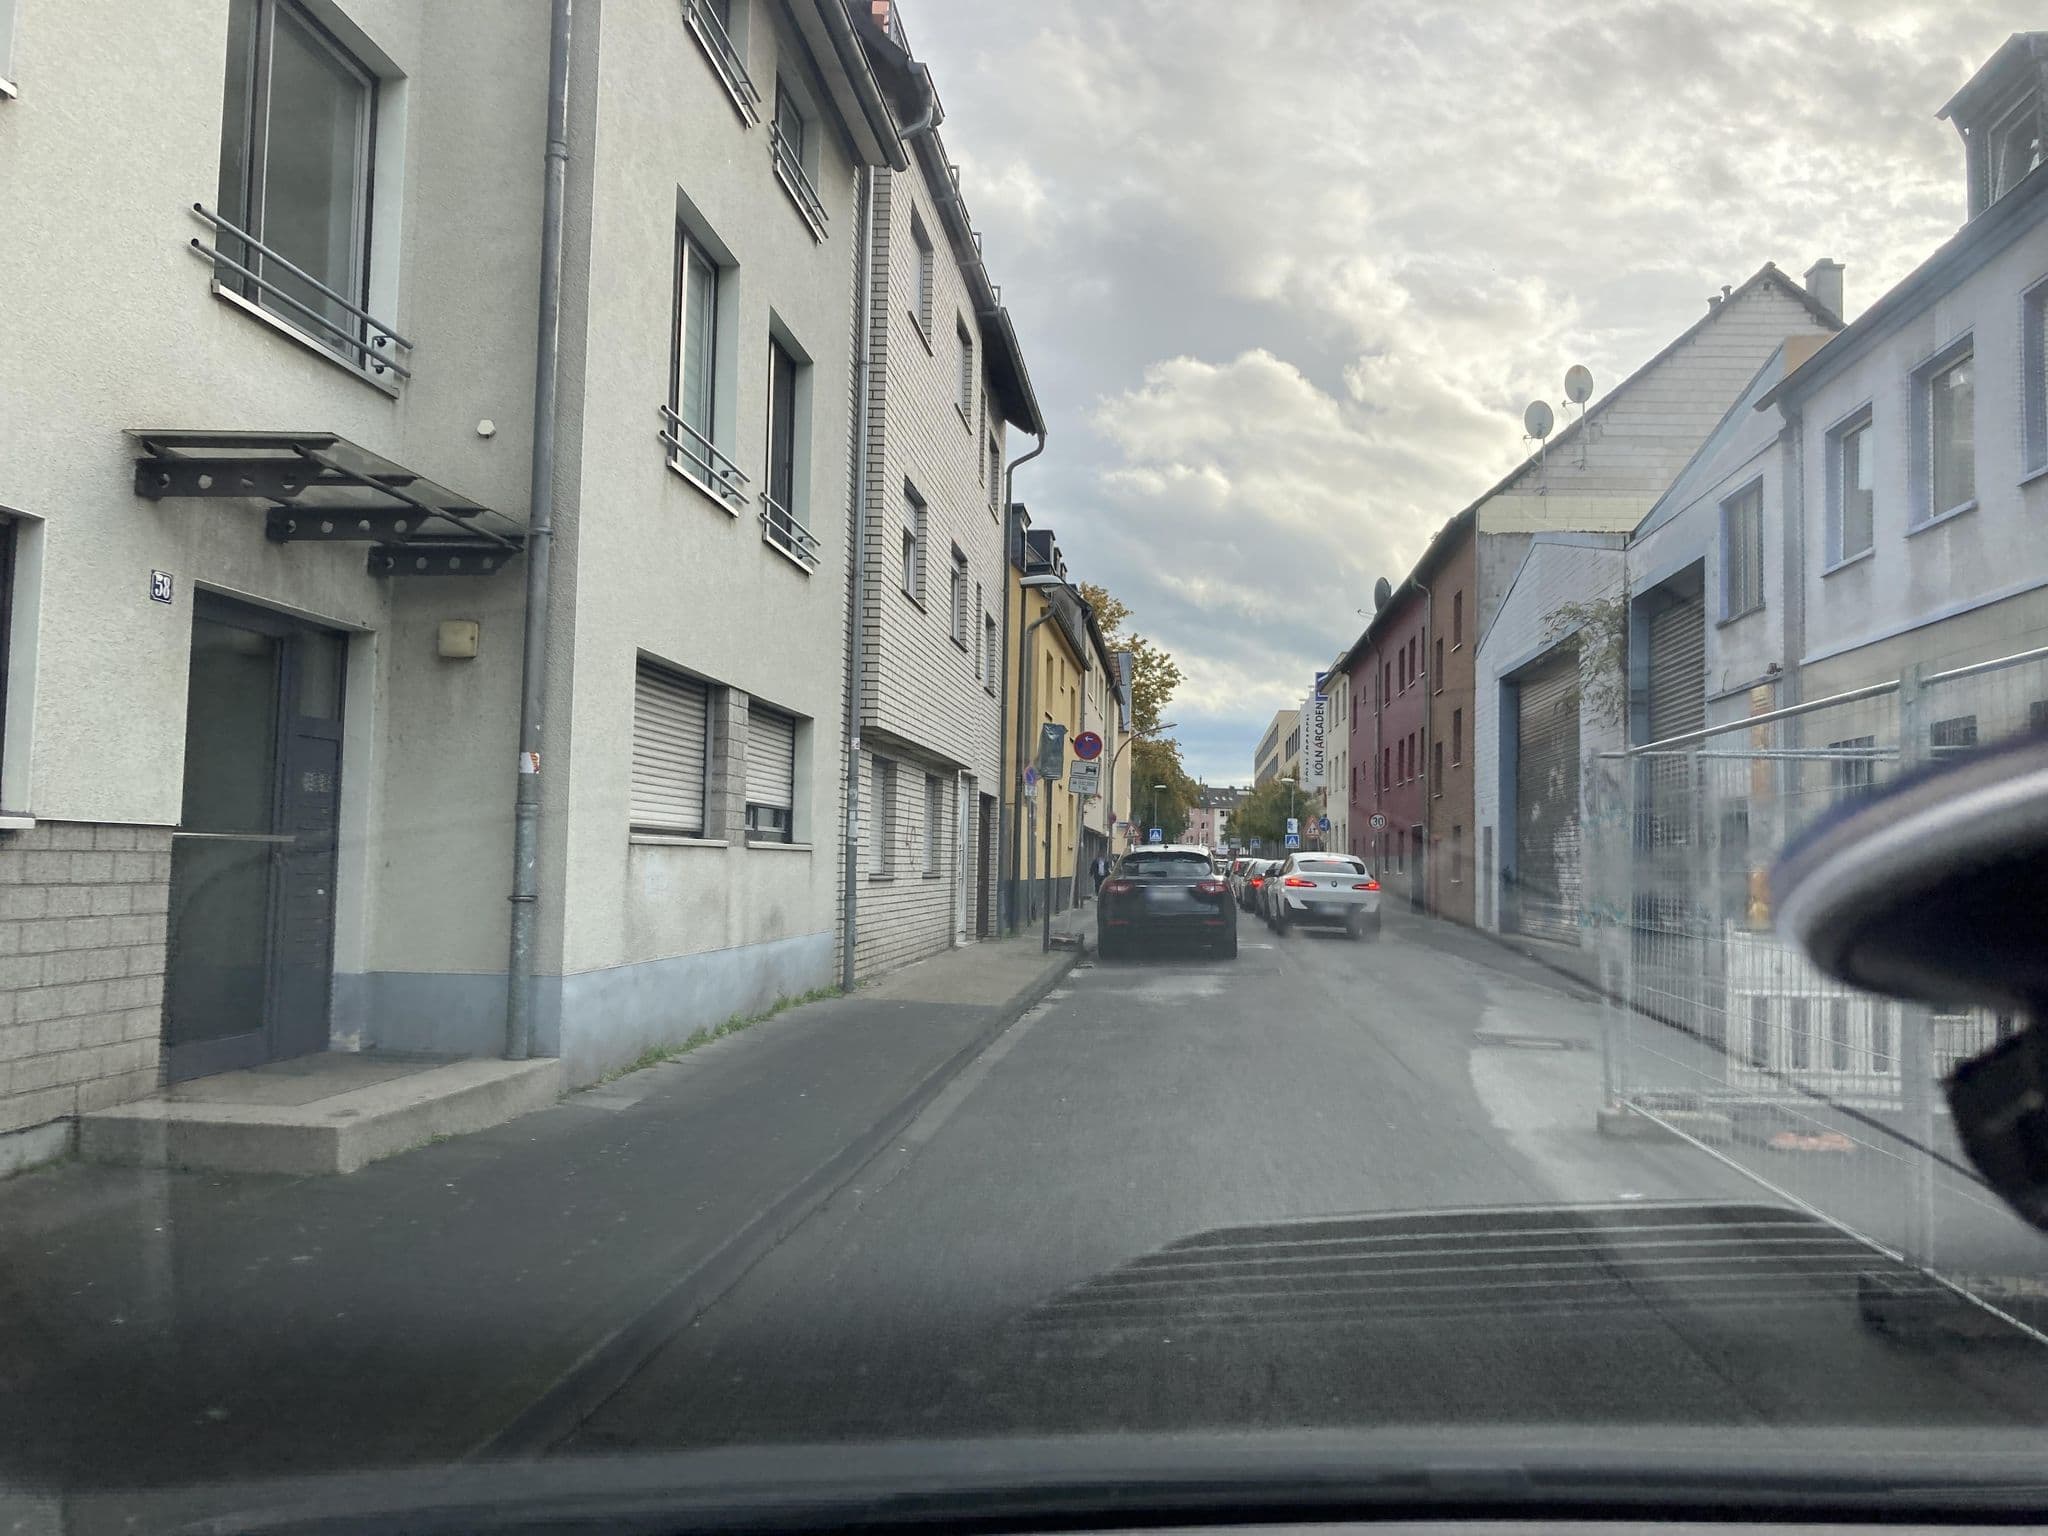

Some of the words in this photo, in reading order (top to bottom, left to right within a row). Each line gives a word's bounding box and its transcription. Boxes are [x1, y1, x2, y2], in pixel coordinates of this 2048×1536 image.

[154, 574, 171, 599] 58
[1313, 702, 1325, 749] ARCADEN
[1372, 816, 1384, 827] 30
